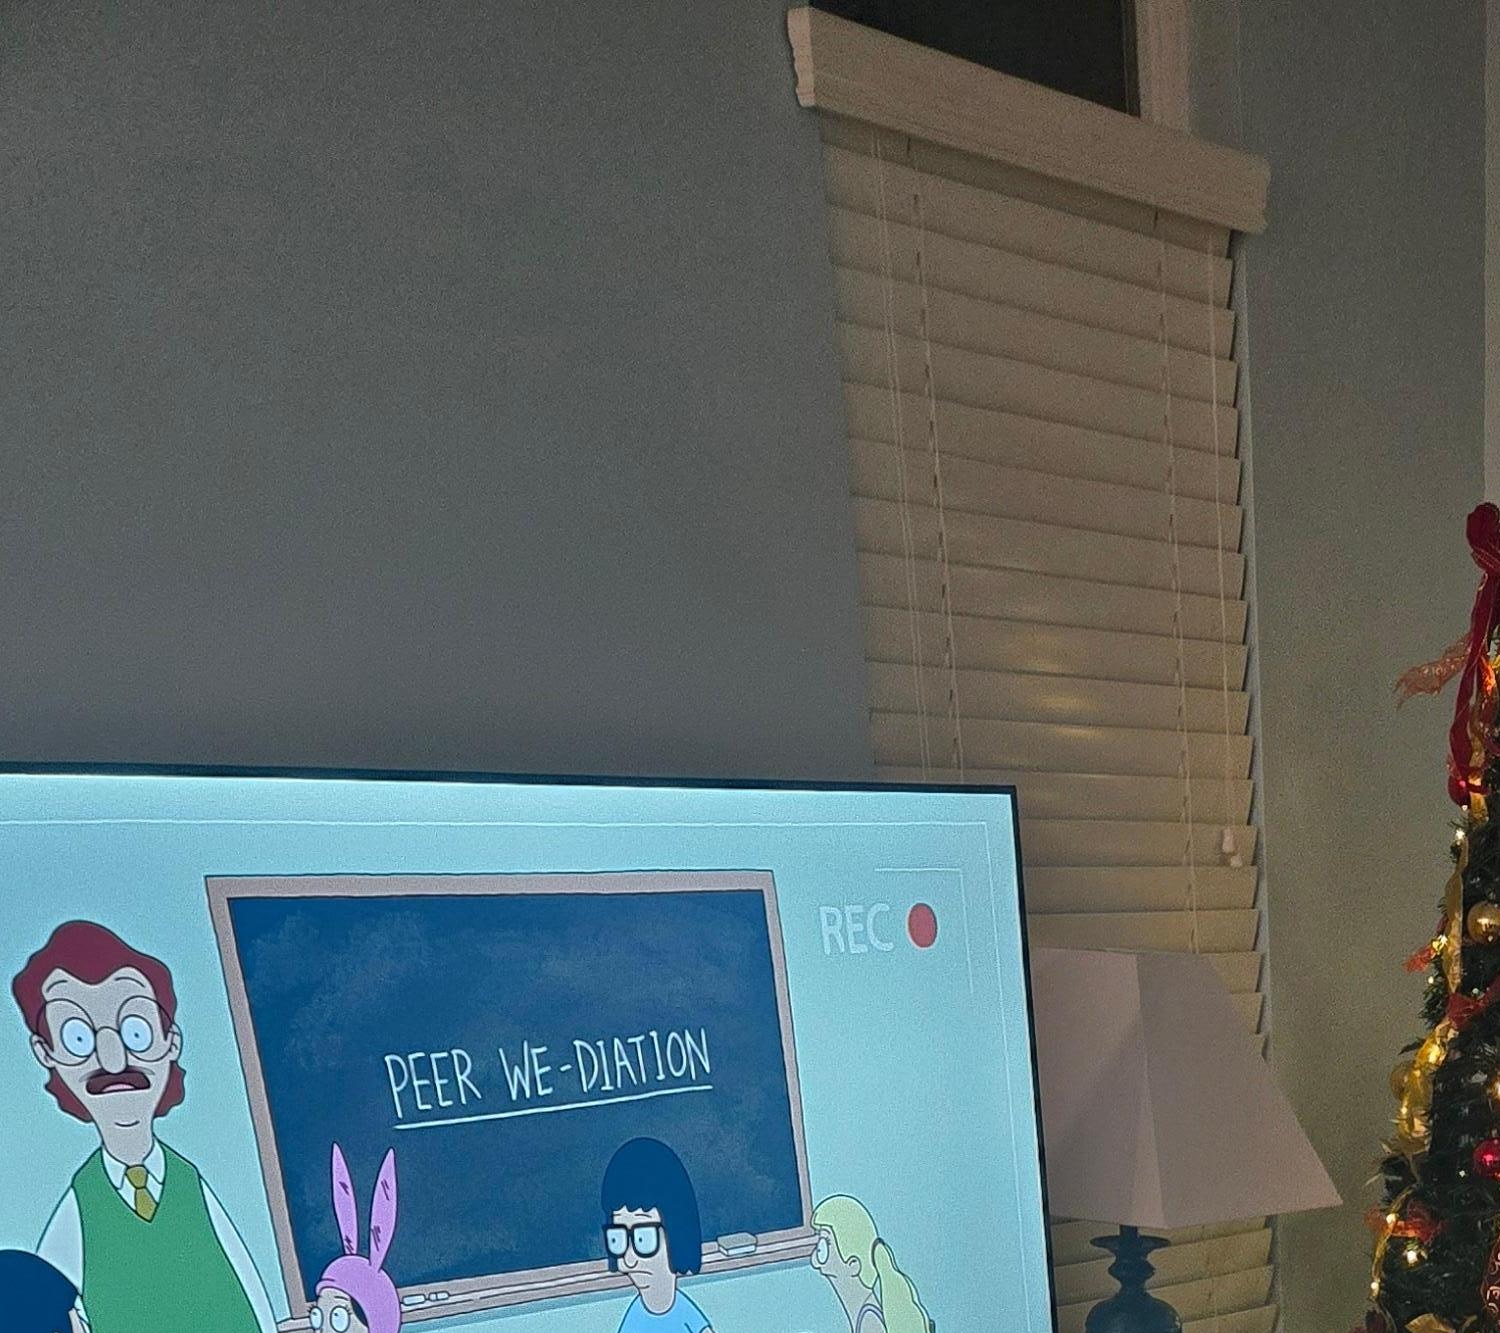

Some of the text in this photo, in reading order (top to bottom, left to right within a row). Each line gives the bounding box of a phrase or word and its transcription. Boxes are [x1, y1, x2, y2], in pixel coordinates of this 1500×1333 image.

[820, 902, 894, 955] REC
[384, 1028, 711, 1119] PEER WE-DIATION
